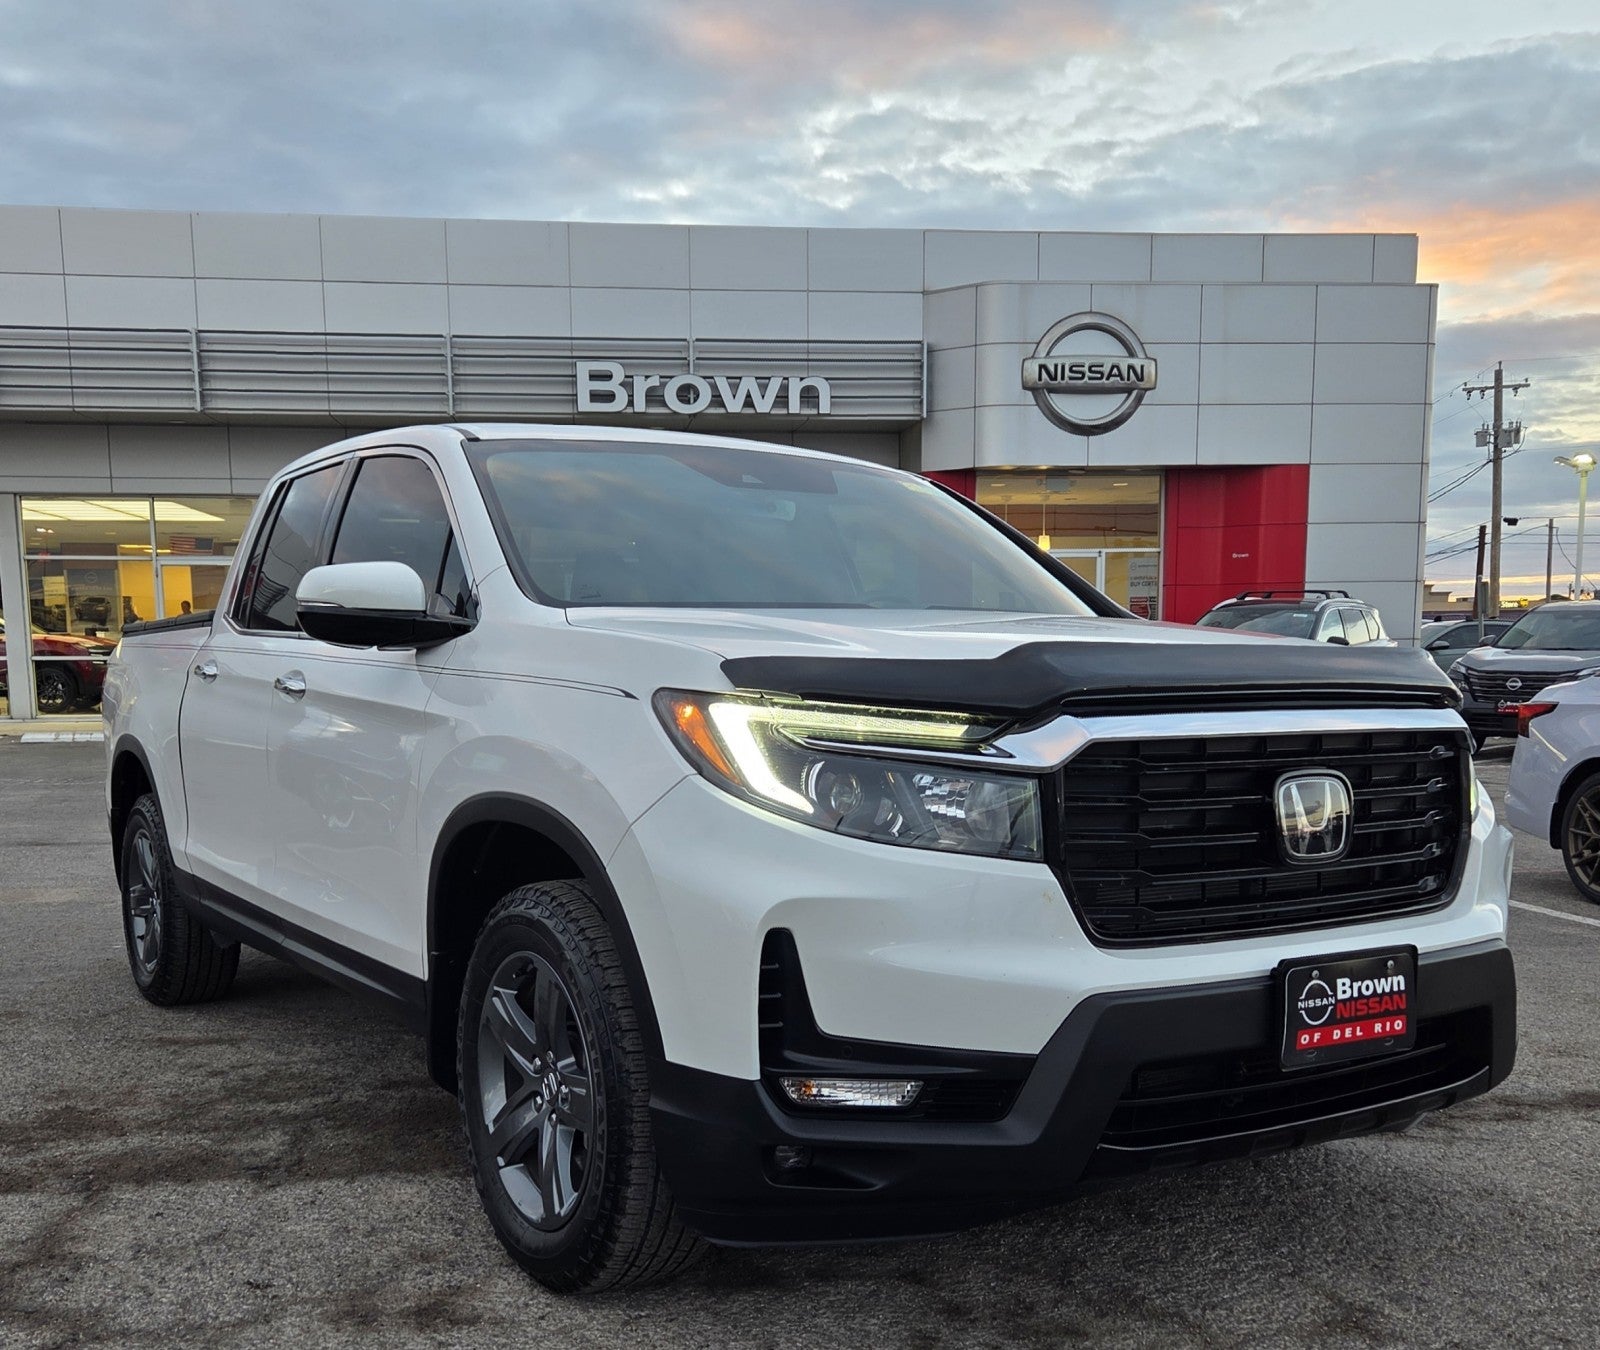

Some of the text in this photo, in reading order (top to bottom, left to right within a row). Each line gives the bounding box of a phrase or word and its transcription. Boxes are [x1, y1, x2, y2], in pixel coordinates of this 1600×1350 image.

[1037, 362, 1145, 382] NISSAN
[576, 361, 831, 414] Brown
[1336, 974, 1406, 1000] Brown
[1298, 996, 1335, 1009] NISSAN
[1336, 993, 1407, 1019] NISSAN
[1301, 1019, 1403, 1044] OF DEL RIO
